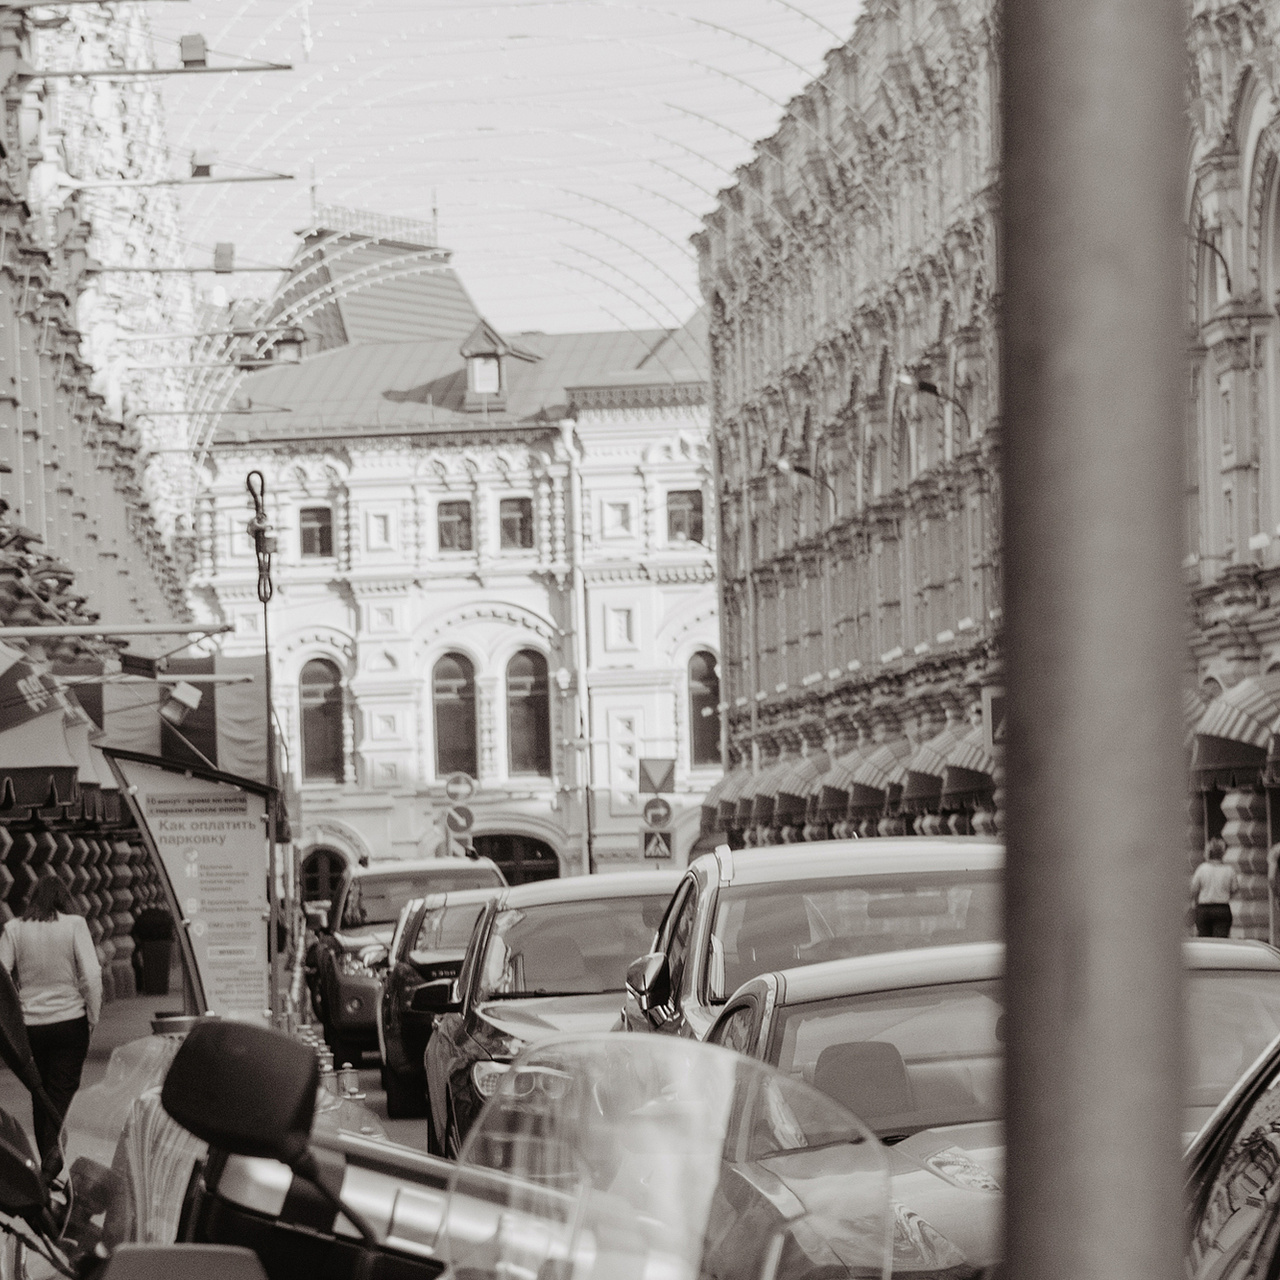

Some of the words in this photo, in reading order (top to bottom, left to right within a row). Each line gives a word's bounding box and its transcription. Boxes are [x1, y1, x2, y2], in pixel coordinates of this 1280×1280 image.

[159, 821, 186, 831] Как
[190, 821, 257, 831] оплатить
[159, 835, 227, 846] парковку
